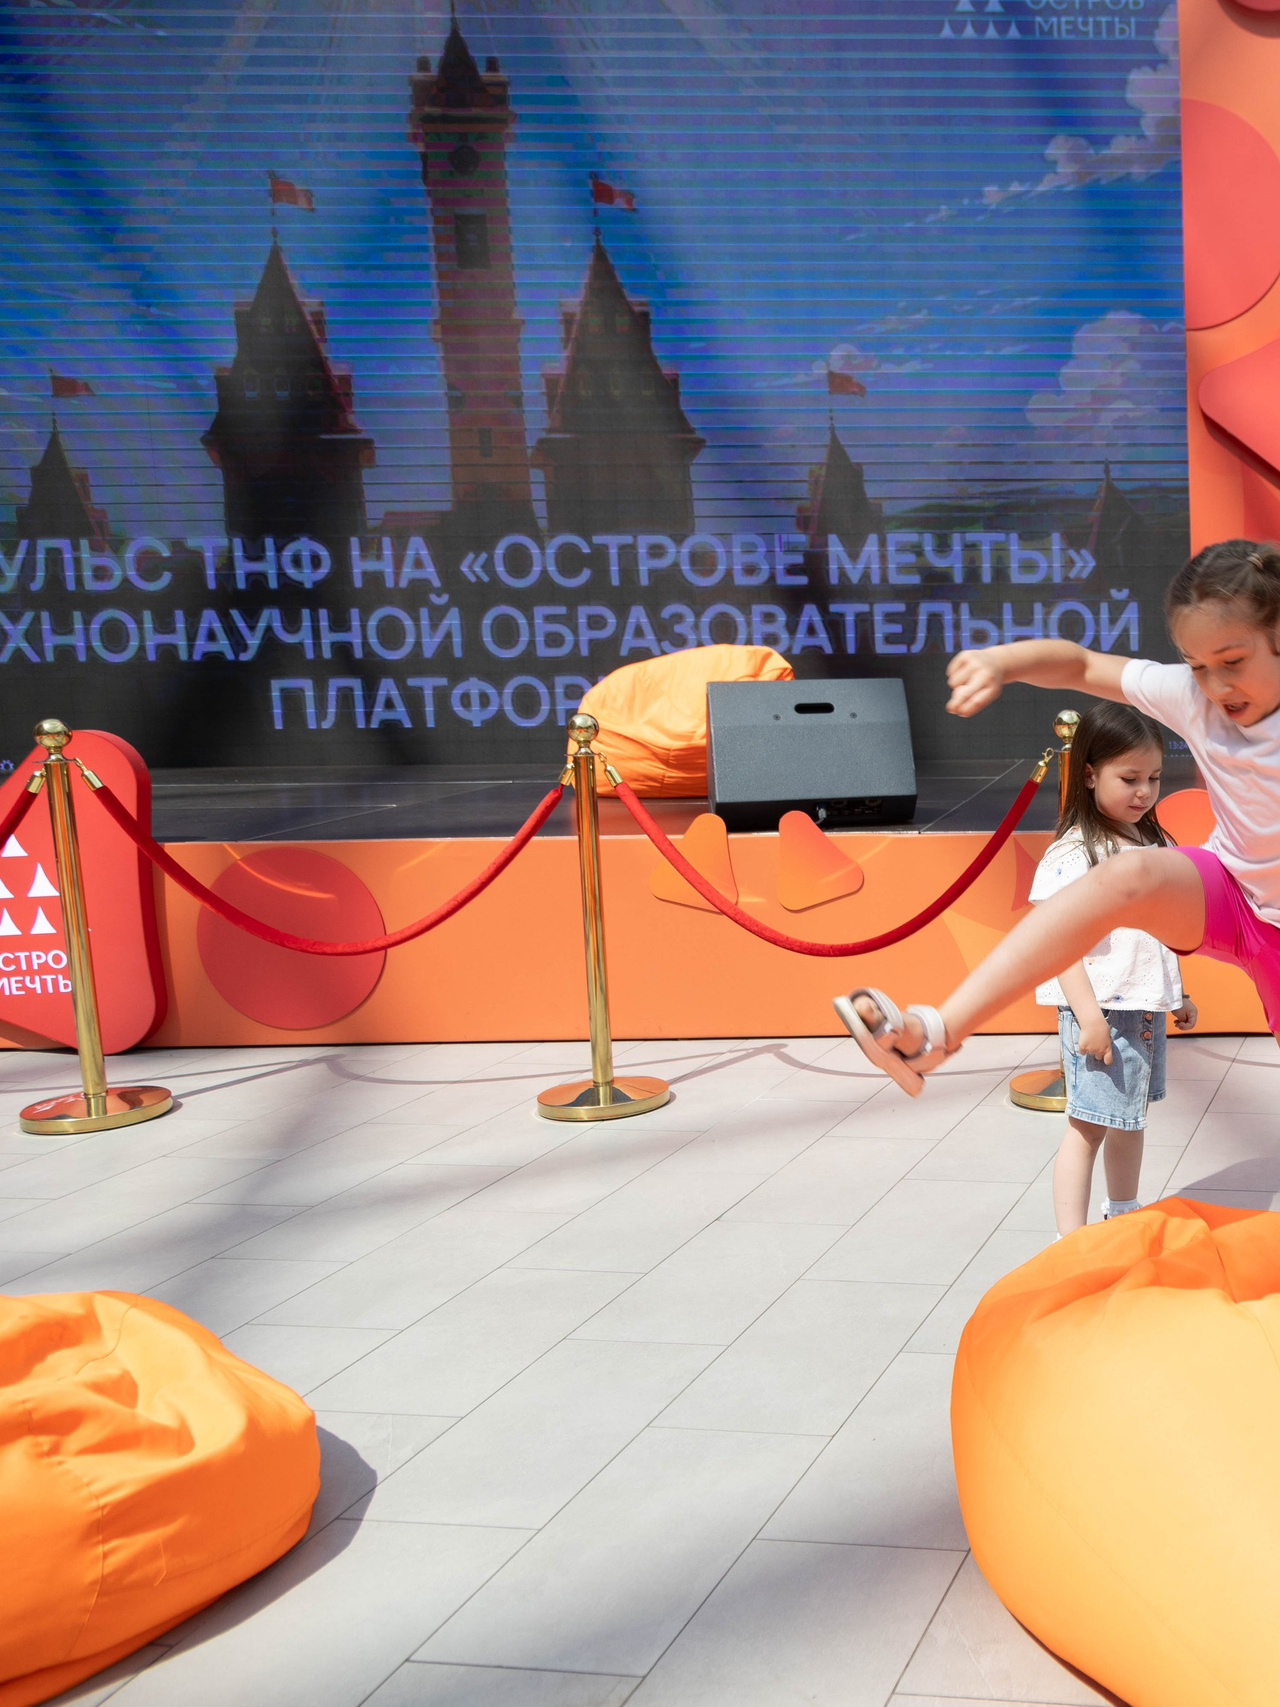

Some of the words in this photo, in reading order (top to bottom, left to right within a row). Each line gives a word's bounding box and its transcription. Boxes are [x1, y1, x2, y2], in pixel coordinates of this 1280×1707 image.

[1034, 16, 1137, 39] МЕЧТЫ
[187, 537, 332, 590] ТНФ
[350, 537, 442, 588] НА
[459, 533, 809, 588] «ОСТРОВЕ
[827, 532, 1097, 586] МЕЧТЫ»
[0, 593, 463, 663] ХНОНАУЧНОЙ
[481, 588, 1140, 658] ОБРАЗОВАТЕЛЬНОЙ
[270, 674, 605, 729] ПЛАТФОР
[0, 949, 68, 971] СТРО
